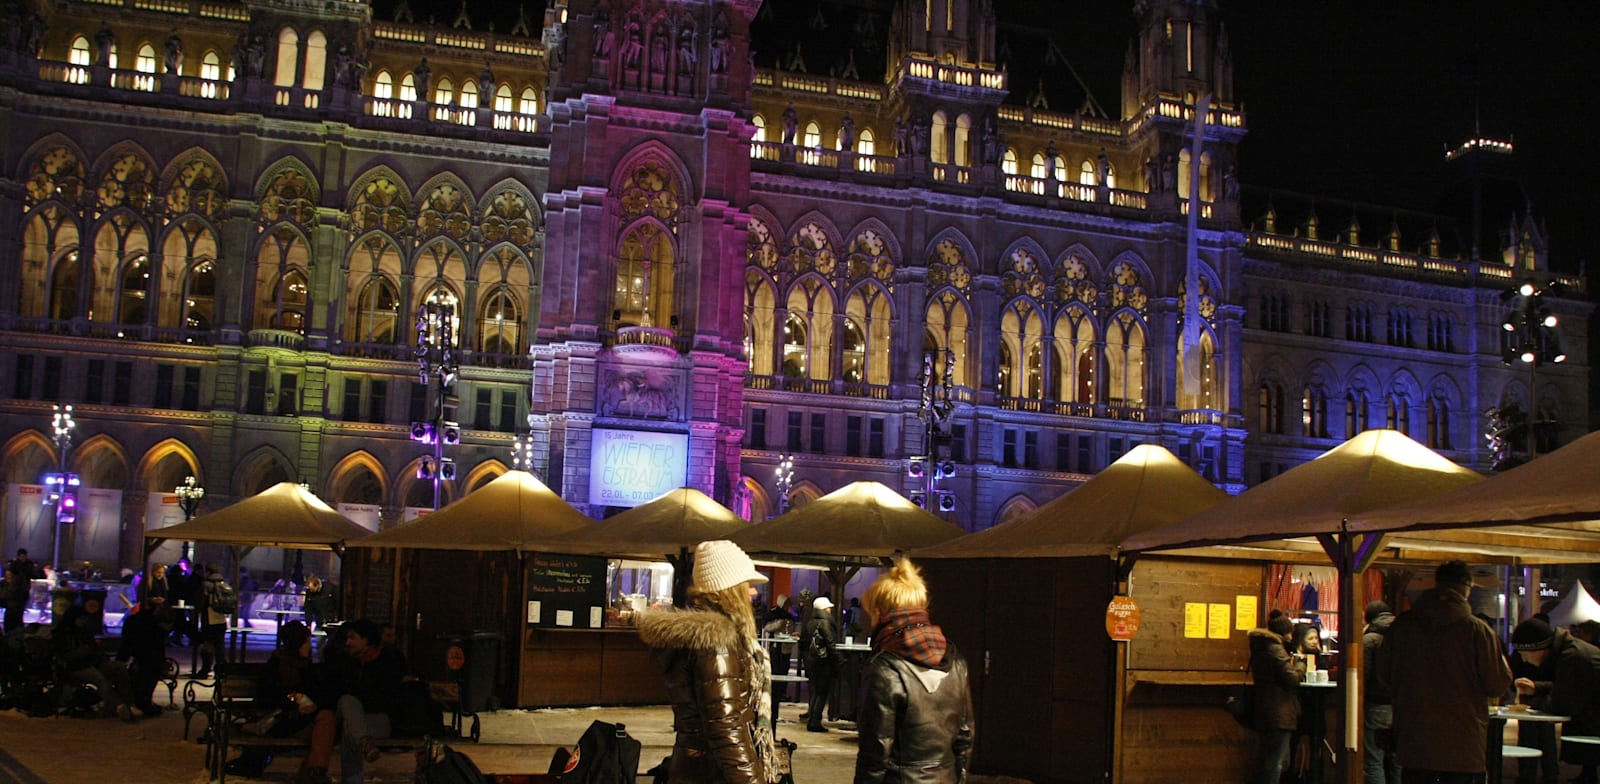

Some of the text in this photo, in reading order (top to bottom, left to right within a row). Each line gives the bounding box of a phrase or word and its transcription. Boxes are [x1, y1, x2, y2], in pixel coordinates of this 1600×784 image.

[604, 431, 635, 440] 15 Jahre
[604, 441, 674, 468] WIENER
[603, 465, 674, 489] EISTRAUM
